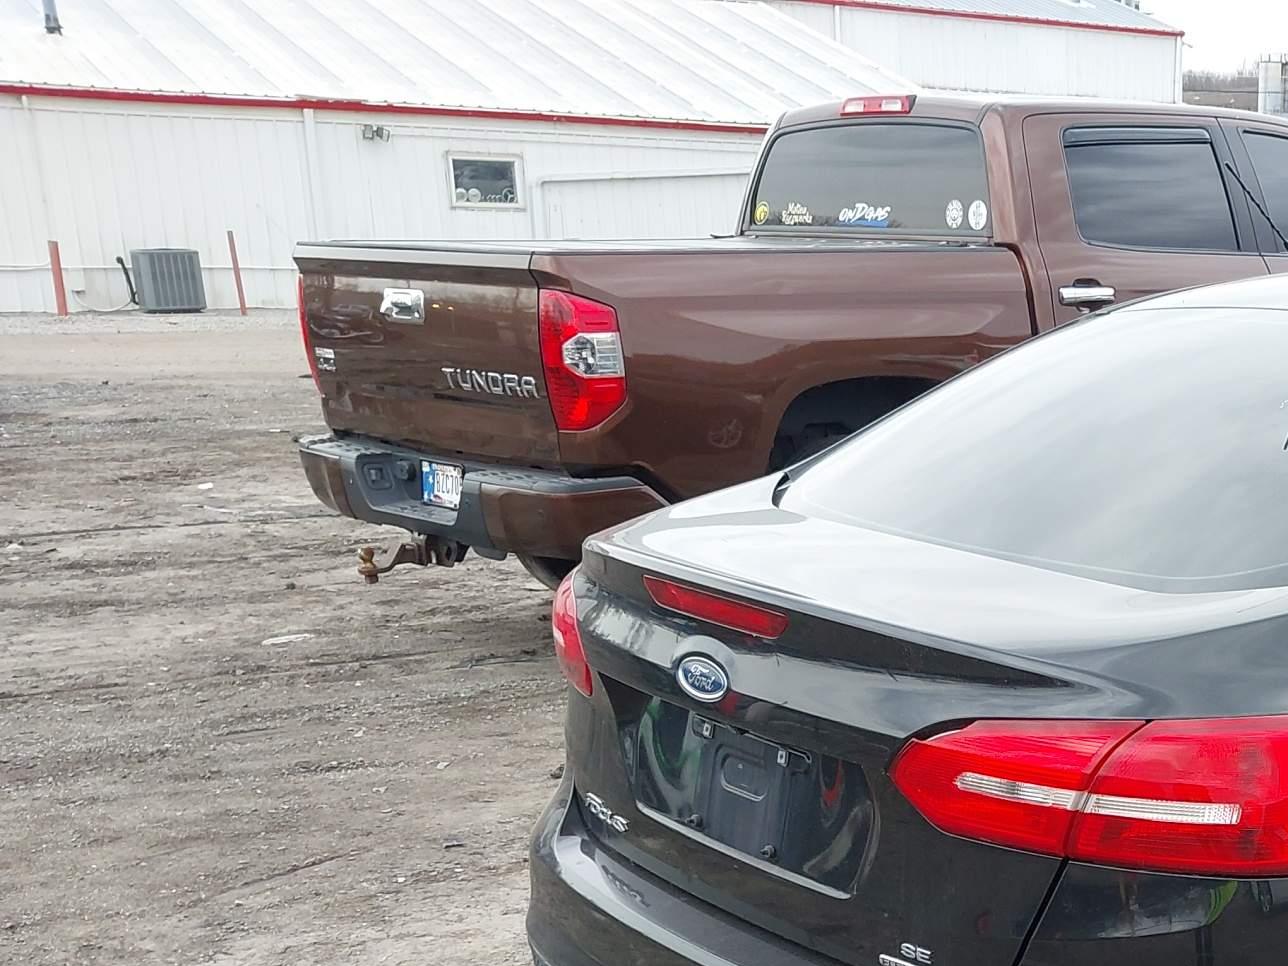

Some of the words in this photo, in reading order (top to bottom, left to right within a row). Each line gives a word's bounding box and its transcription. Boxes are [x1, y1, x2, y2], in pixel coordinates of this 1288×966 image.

[441, 367, 541, 398] TUNDRA
[687, 663, 715, 691] Ford
[900, 942, 932, 965] SE
